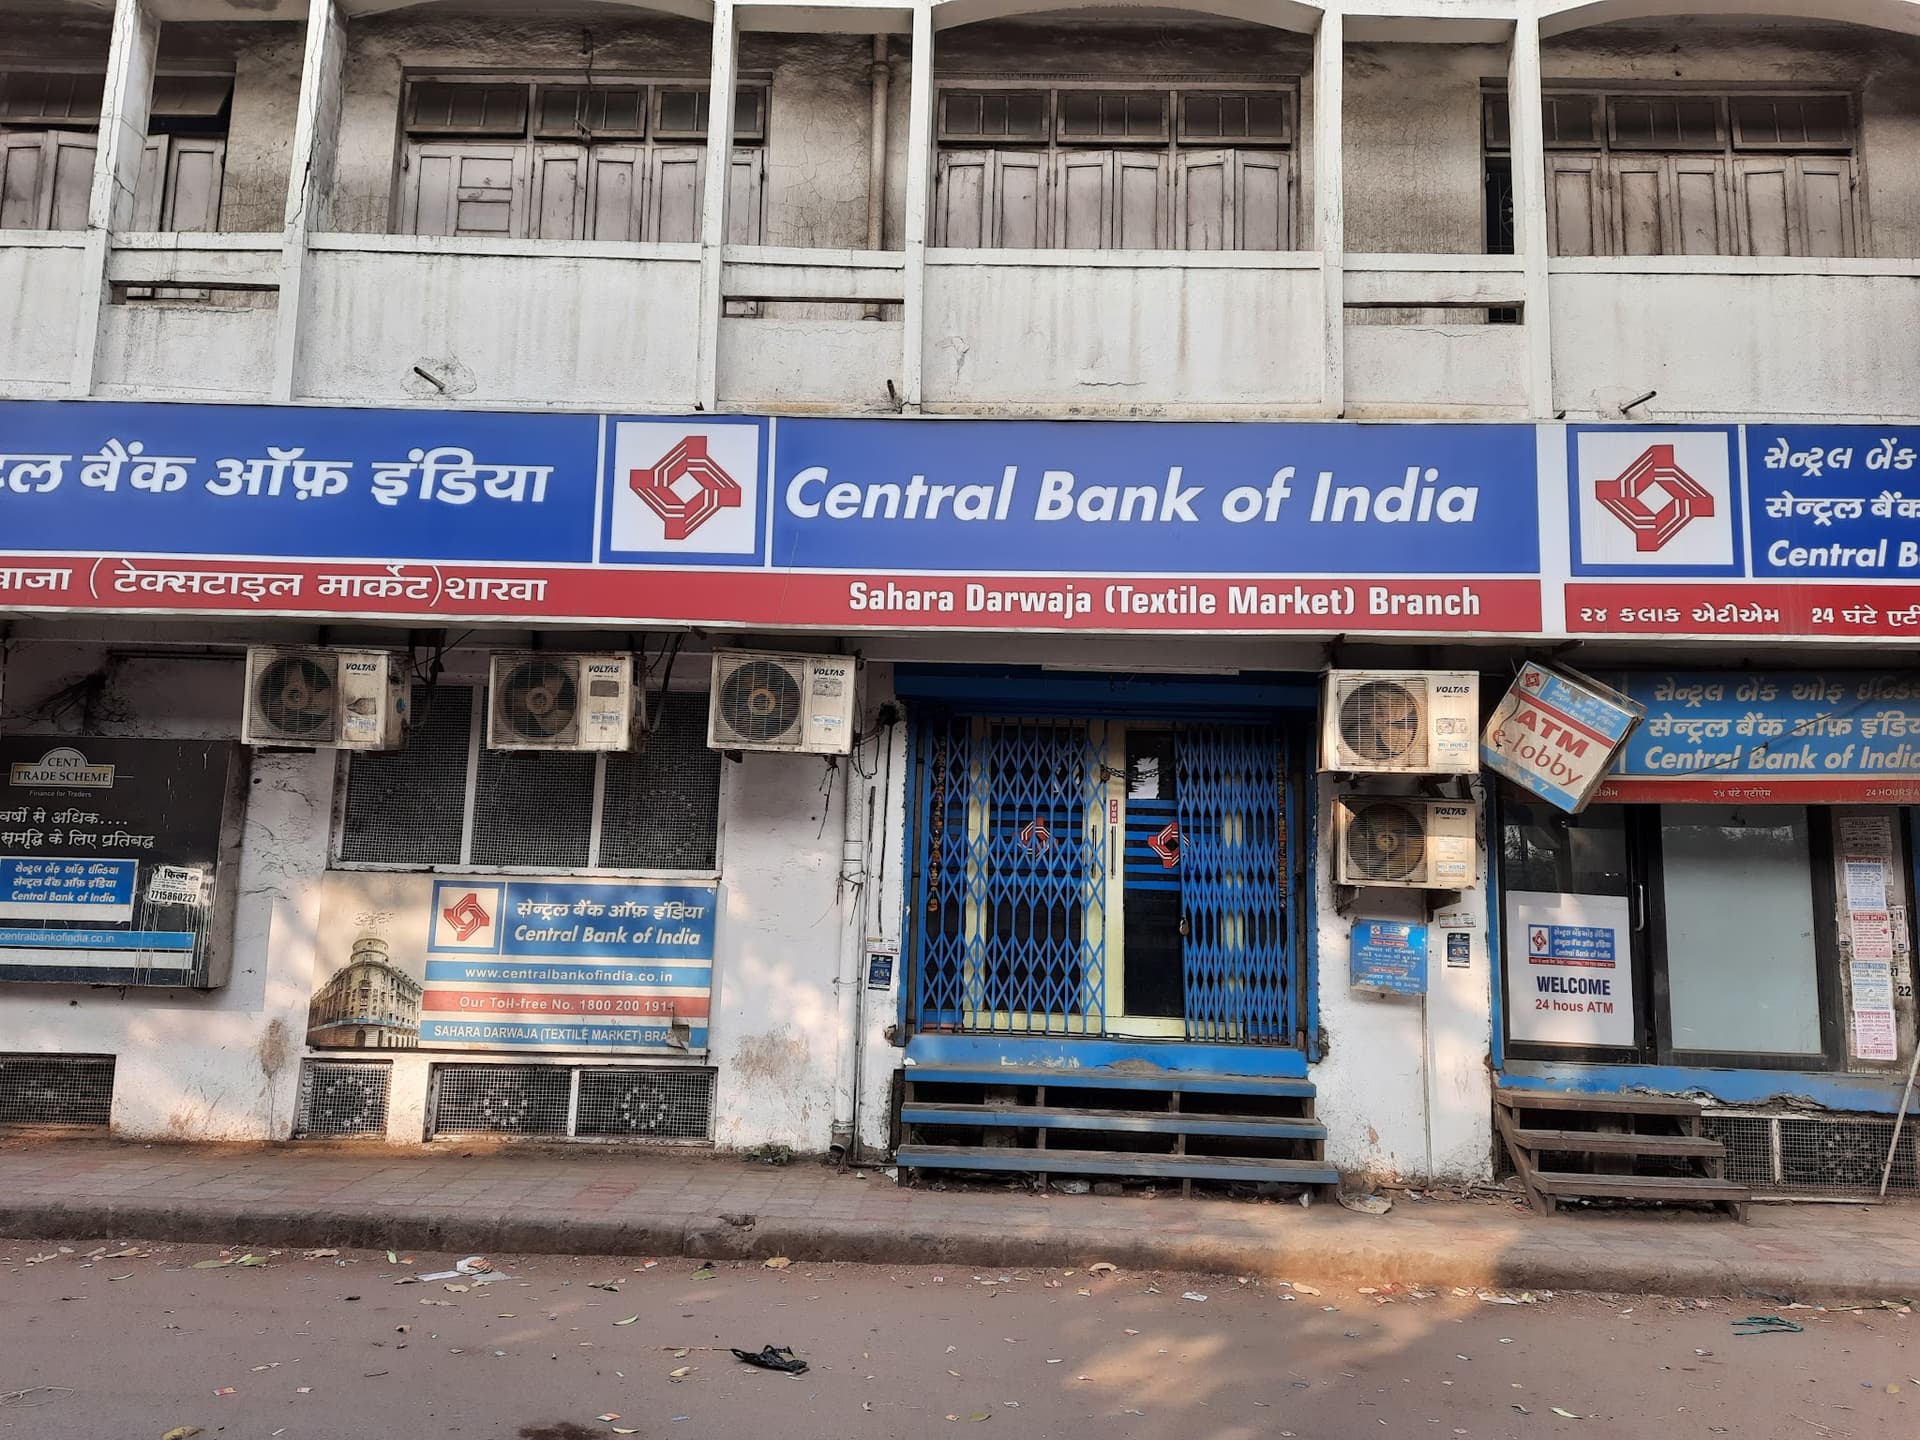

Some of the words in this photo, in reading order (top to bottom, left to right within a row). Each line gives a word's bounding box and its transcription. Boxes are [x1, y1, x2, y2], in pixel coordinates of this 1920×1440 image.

[80, 437, 196, 492] बैंक
[371, 447, 554, 506] इंडिया
[786, 466, 1015, 521] Central
[1034, 467, 1204, 522] Bank
[1221, 465, 1296, 523] of
[1310, 468, 1479, 524] India
[1765, 490, 1866, 526] सेन्ट्रल
[1768, 538, 1888, 567] Central
[113, 559, 304, 602] टेक्सटाइल
[849, 581, 954, 611] Sahara
[965, 583, 1092, 619] Darwaja
[1104, 585, 1217, 615] (Textile
[1227, 586, 1355, 616] Market)
[1369, 586, 1480, 616] Branch
[1811, 607, 1834, 624] 24
[346, 663, 377, 671] VOLTAS
[588, 664, 619, 673] VOLTAS
[813, 668, 845, 677] VOLTAS
[1436, 686, 1470, 694] VOLTAS
[1514, 709, 1590, 759] ATM
[47, 757, 80, 768] CENT
[1492, 729, 1584, 787] e-lobby
[1644, 745, 1743, 770] Central
[1748, 744, 1818, 770] Bank
[1824, 744, 1857, 770] of
[15, 771, 56, 781] TRADE
[59, 772, 109, 782] SCHEME
[1435, 807, 1467, 816] VOLTAS
[68, 830, 97, 849] लिए
[11, 891, 47, 901] Central
[49, 891, 74, 902] Bank
[77, 892, 88, 902] of
[90, 892, 116, 903] India
[514, 925, 578, 942] Central
[582, 926, 629, 943] Bank
[632, 927, 652, 944] of
[656, 928, 701, 945] India
[465, 967, 673, 983] www.centralbankofindia.co.in
[1536, 976, 1611, 995] WELCOME
[459, 996, 485, 1009] Our
[551, 999, 575, 1011] No.
[579, 1000, 611, 1012] 1800
[615, 1000, 640, 1011] 200
[1535, 999, 1549, 1010] 24
[1553, 1000, 1584, 1012] hous
[1587, 1002, 1613, 1014] ATM
[434, 1025, 481, 1038] SAHARA
[483, 1026, 538, 1040] DARWAJA
[540, 1027, 588, 1041] (TEXTILE
